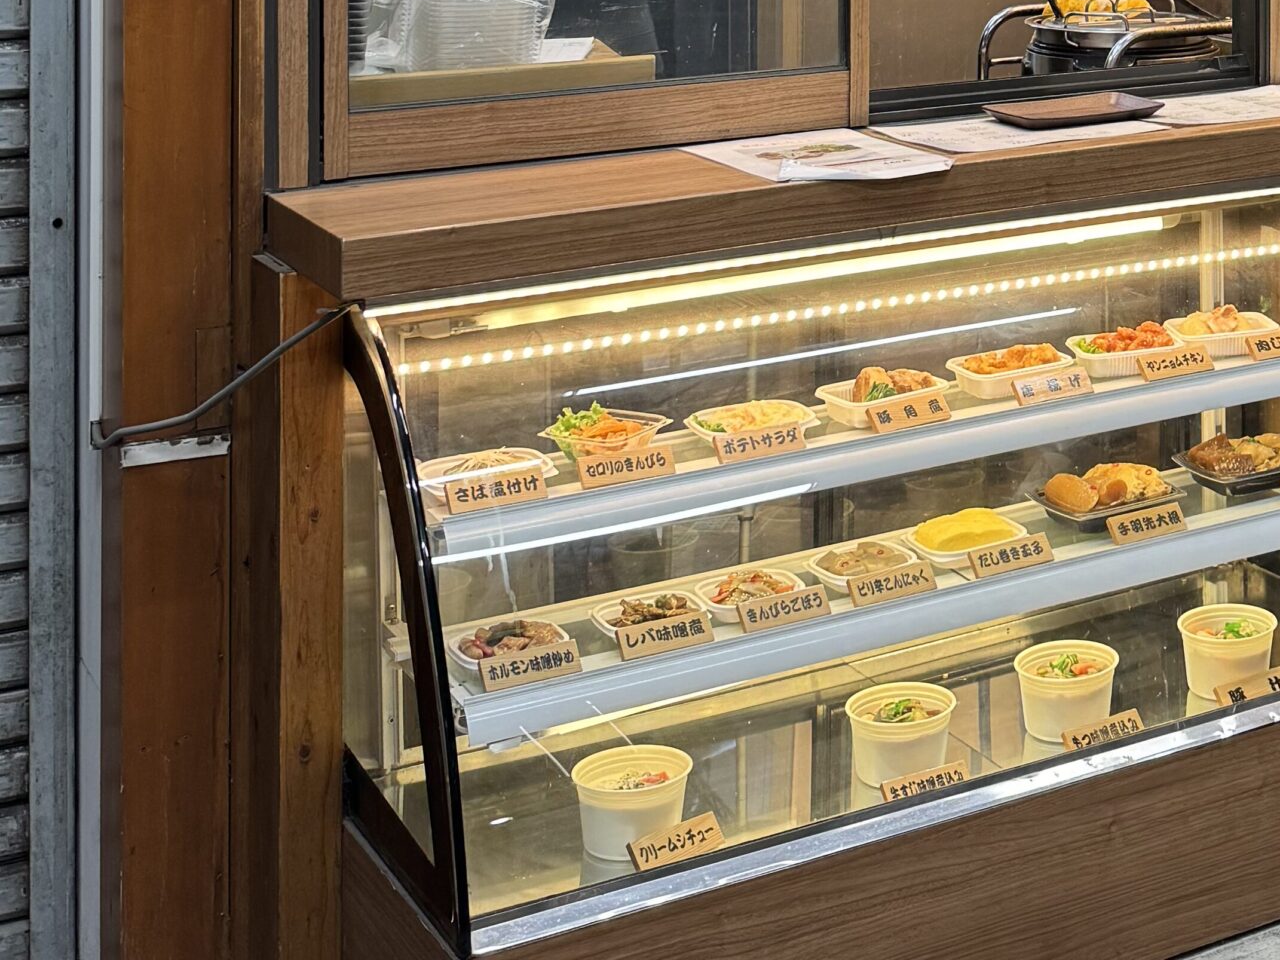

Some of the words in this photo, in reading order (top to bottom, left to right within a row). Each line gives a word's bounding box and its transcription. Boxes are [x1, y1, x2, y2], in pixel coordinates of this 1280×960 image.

[1145, 352, 1205, 372] ヤンニョムチキン
[1021, 373, 1081, 398] 唐揚げ
[876, 398, 944, 425] 豚角煮
[723, 427, 798, 455] ポテトサラダ
[585, 452, 667, 478] セロリのきんぴら
[454, 474, 540, 503] さば煮付け
[1117, 511, 1182, 536] 手羽先大根
[978, 540, 1044, 568] だし巻き玉子
[856, 568, 930, 598] ピリ辛こんにゃく
[746, 591, 823, 624] きんぴらごぼう
[625, 618, 706, 649] レバ味噌煮
[488, 649, 575, 681] ホルモン味噌炒め
[639, 824, 715, 864] クリームシチュー
